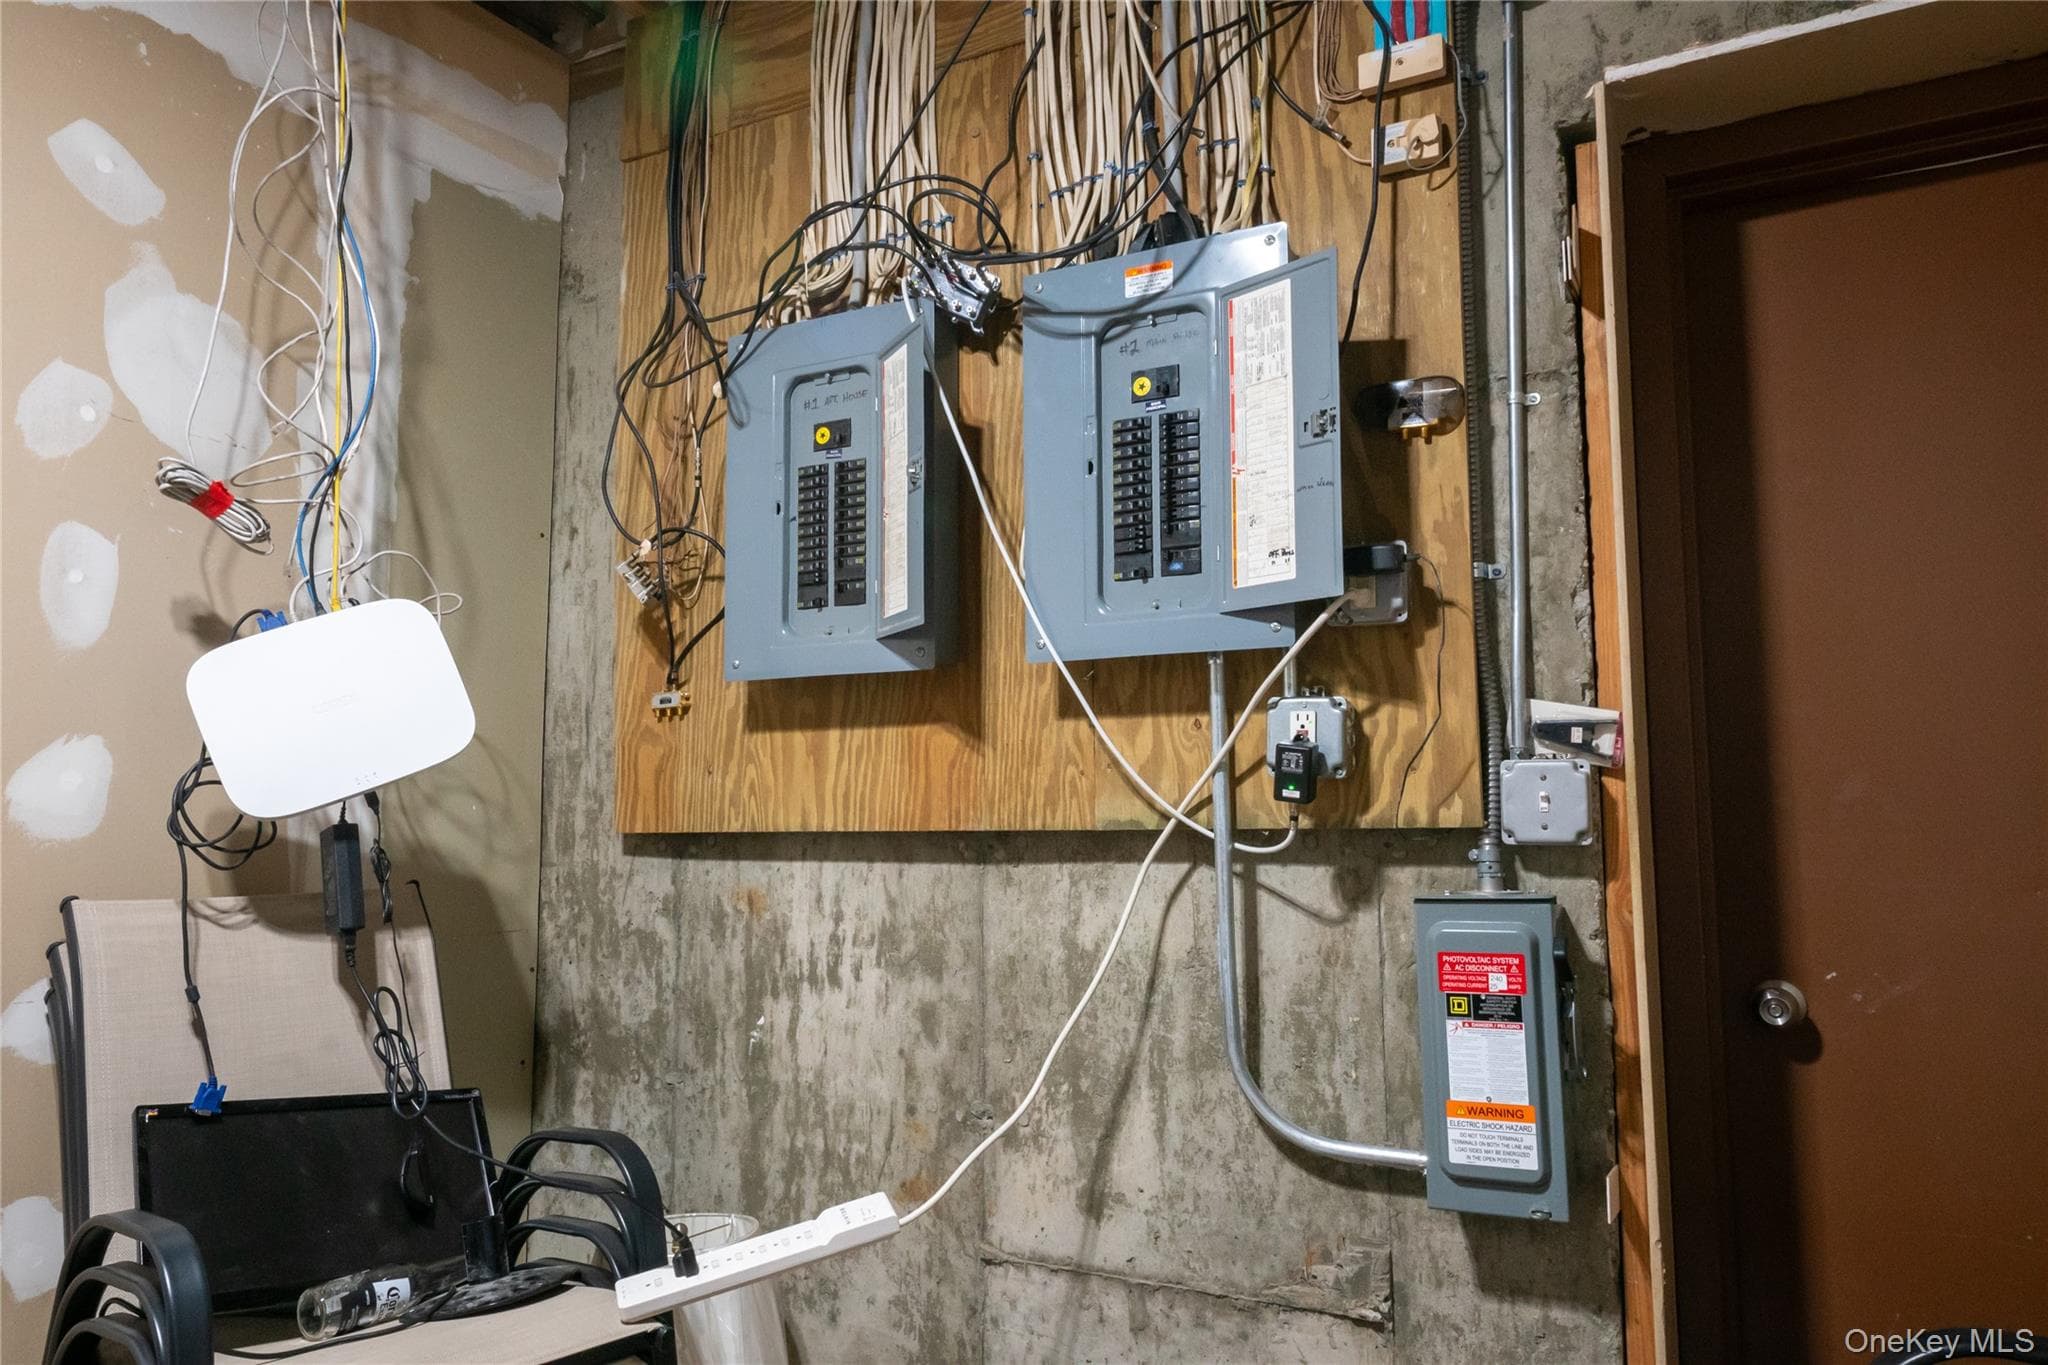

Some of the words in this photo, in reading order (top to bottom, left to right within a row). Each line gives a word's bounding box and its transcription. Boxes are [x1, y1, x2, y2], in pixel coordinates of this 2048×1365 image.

[804, 398, 818, 410] #1
[1443, 956, 1491, 964] PHOTOVOLTAIC
[1492, 957, 1520, 965] SYSTEM
[1467, 1107, 1524, 1119] WARNING
[1450, 1120, 1480, 1129] ELECTRIC
[1481, 1122, 1503, 1130] SHOCK
[1506, 1125, 1533, 1133] HAZARD
[1503, 1150, 1531, 1158] ENERGIZED
